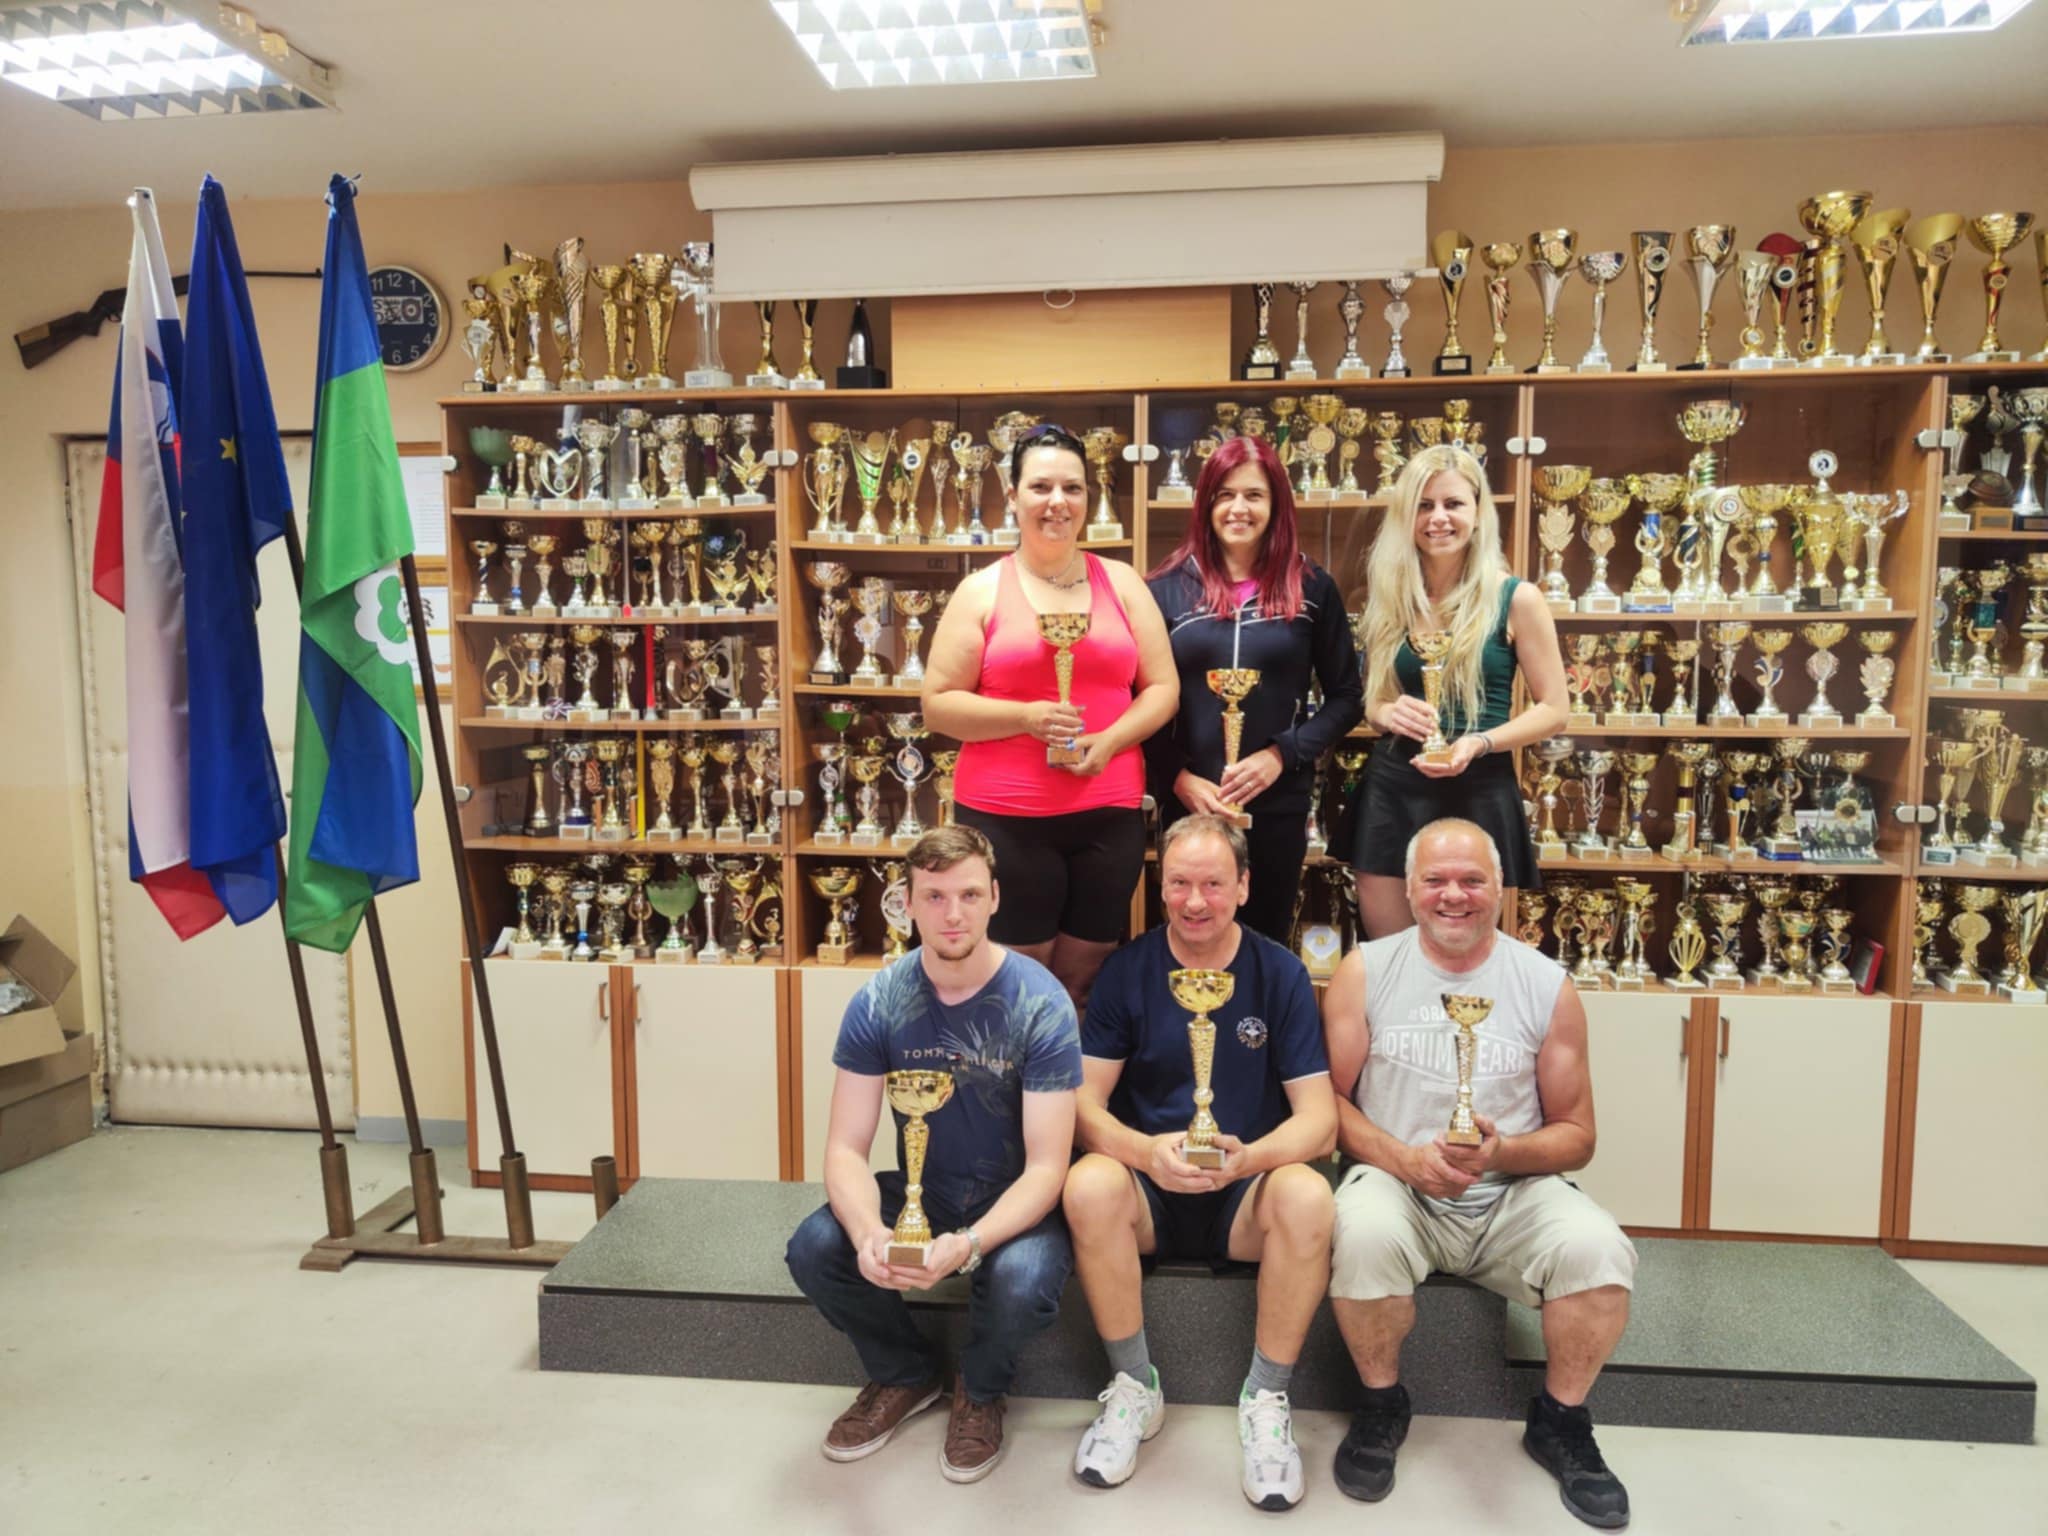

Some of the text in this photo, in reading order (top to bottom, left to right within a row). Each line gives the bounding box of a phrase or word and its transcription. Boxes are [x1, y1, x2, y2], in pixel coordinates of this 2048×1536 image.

[372, 278, 383, 292] 11
[387, 273, 402, 288] 12
[424, 294, 433, 308] 2
[429, 312, 438, 327] 3
[423, 333, 432, 345] 4
[392, 348, 402, 364] 6
[410, 345, 420, 359] 5
[1386, 1031, 1517, 1073] DENIM EAR
